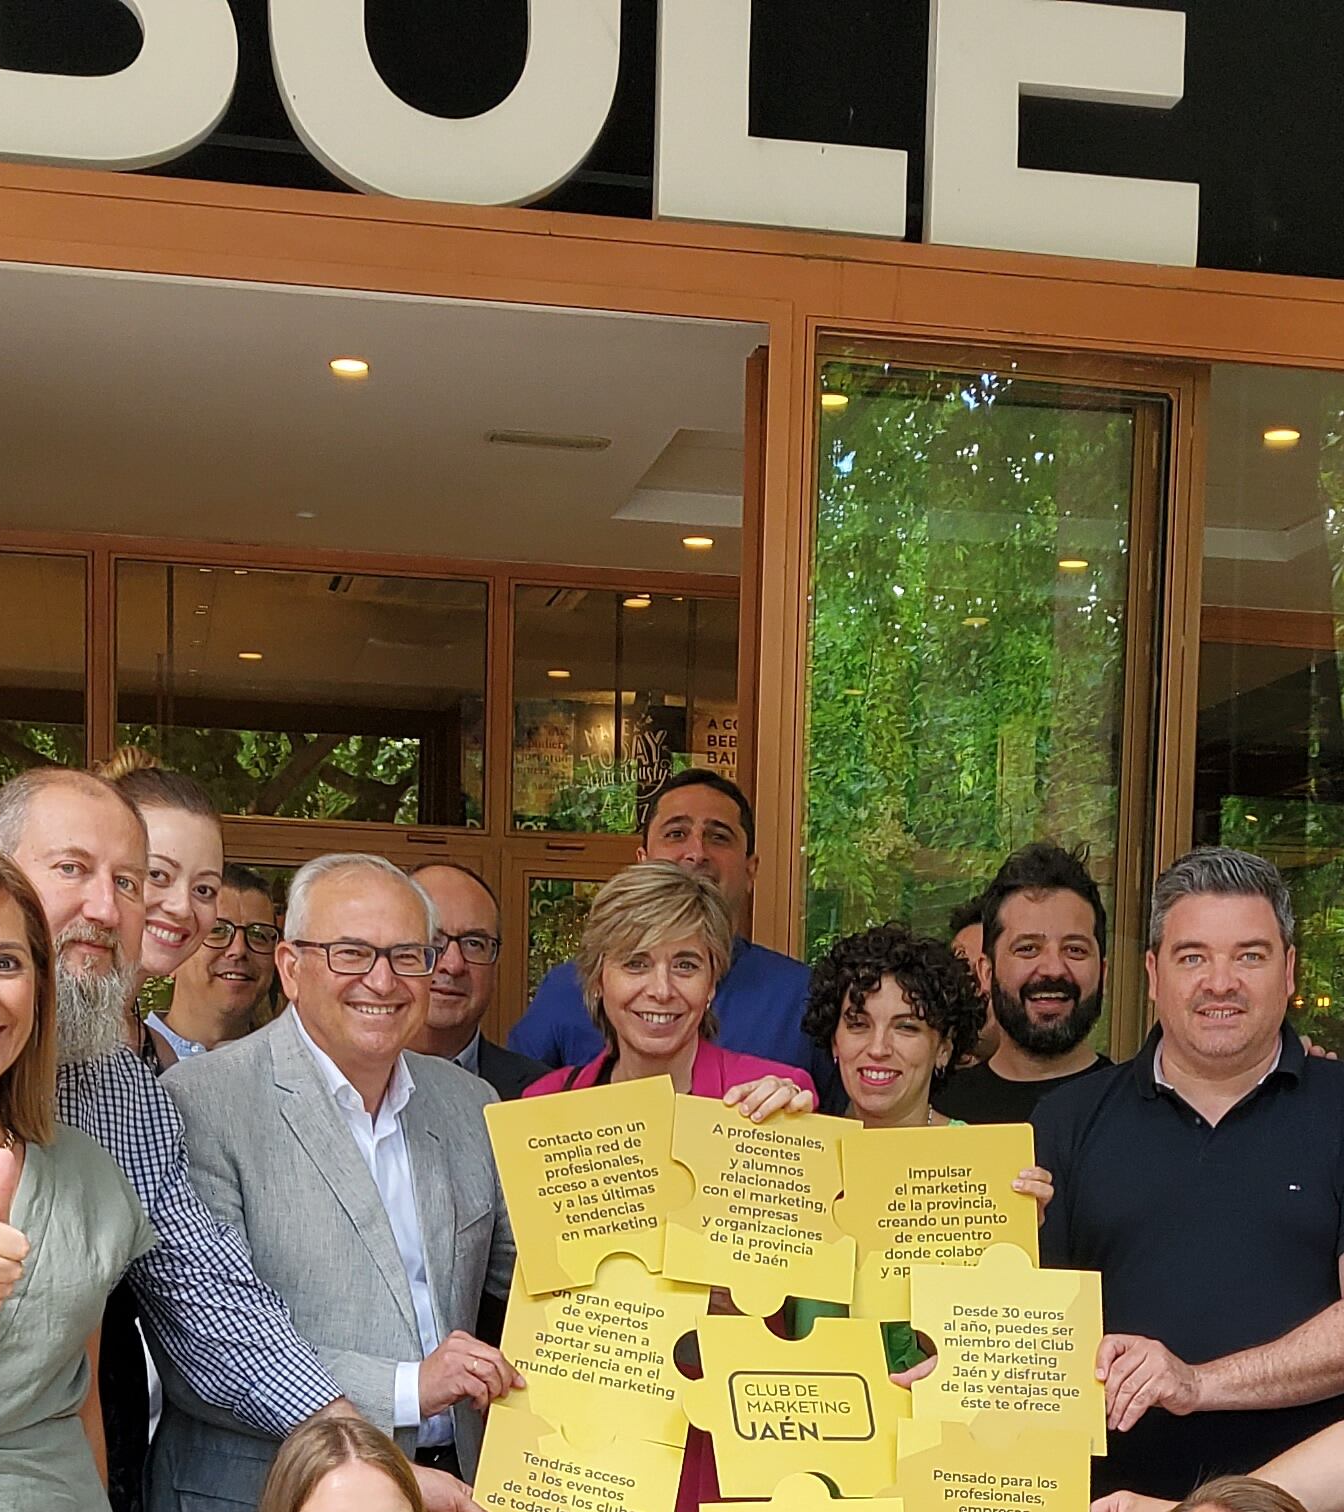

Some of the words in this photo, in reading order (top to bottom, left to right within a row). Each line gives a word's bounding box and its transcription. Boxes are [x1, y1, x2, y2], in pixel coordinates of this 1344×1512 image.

[528, 1130, 593, 1149] Contacto
[596, 1125, 623, 1138] con
[626, 1121, 646, 1133] un
[727, 1127, 825, 1152] profesionales,
[544, 1144, 593, 1163] amplia
[595, 1138, 620, 1155] red
[623, 1136, 642, 1149] de
[735, 1141, 801, 1162] docentes
[545, 1154, 644, 1183] profesionales,
[742, 1158, 804, 1177] alumnos
[908, 1165, 972, 1182] Impulsar
[537, 1180, 587, 1197] acceso
[602, 1167, 659, 1185] eventos
[720, 1171, 811, 1194] relacionados
[911, 1180, 987, 1196] marketing
[577, 1193, 599, 1207] las
[601, 1184, 656, 1202] últimas
[702, 1185, 729, 1198] con
[749, 1191, 826, 1214] marketing,
[887, 1199, 906, 1212] de
[926, 1195, 997, 1214] provincia,
[565, 1201, 645, 1225] tendencias
[728, 1204, 799, 1223] empresas
[877, 1214, 937, 1229] creando
[941, 1216, 960, 1227] un
[964, 1212, 1008, 1229] punto
[561, 1230, 580, 1242] en
[583, 1215, 658, 1238] marketing
[714, 1218, 823, 1241] organizaciones
[894, 1231, 913, 1244] de
[917, 1230, 992, 1243] encuentro
[710, 1230, 728, 1243] de
[748, 1238, 813, 1256] provincia
[884, 1246, 931, 1260] donde
[935, 1244, 986, 1258] colabo
[732, 1249, 751, 1262] de
[754, 1252, 788, 1268] Jaén
[575, 1292, 610, 1308] gran
[614, 1301, 665, 1319] equipo
[953, 1305, 999, 1318] Desde
[1001, 1307, 1020, 1319] 30
[1024, 1310, 1064, 1321] euros
[562, 1304, 581, 1317] de
[585, 1310, 649, 1331] expertos
[943, 1319, 956, 1332] al
[960, 1320, 991, 1335] año,
[995, 1322, 1048, 1336] puedes
[1051, 1327, 1074, 1337] ser
[555, 1320, 584, 1334] que
[588, 1324, 637, 1345] vienen
[944, 1334, 1011, 1349] miembro
[1014, 1337, 1037, 1350] del
[1040, 1338, 1074, 1352] Club
[535, 1332, 591, 1351] aportar
[593, 1343, 611, 1355] su
[614, 1347, 664, 1365] amplia
[960, 1350, 980, 1363] de
[983, 1351, 1057, 1369] Marketing
[535, 1348, 620, 1372] experiencia
[624, 1365, 643, 1377] en
[646, 1368, 660, 1380] el
[952, 1365, 988, 1378] Jaén
[1004, 1367, 1067, 1382] disfrutar
[514, 1359, 568, 1378] mundo
[571, 1369, 595, 1383] del
[598, 1375, 675, 1401] marketing
[745, 1384, 790, 1396] CLUB
[794, 1384, 819, 1397] DE
[940, 1380, 960, 1393] de
[963, 1381, 984, 1393] las
[986, 1383, 1048, 1398] ventajas
[1051, 1387, 1080, 1400] que
[747, 1400, 851, 1414] MARKETING
[960, 1396, 992, 1409] éste
[994, 1399, 1010, 1410] te
[1013, 1398, 1061, 1412] ofrece
[737, 1416, 820, 1440] JAÉN
[523, 1451, 582, 1475] Tendrás
[584, 1469, 636, 1488] acceso
[933, 1469, 997, 1485] Pensado
[1000, 1476, 1033, 1489] para
[1037, 1475, 1058, 1490] los
[503, 1480, 522, 1494] de
[526, 1485, 568, 1504] todos
[571, 1494, 593, 1510] los
[541, 1471, 563, 1487] los
[566, 1480, 625, 1501] eventos
[944, 1487, 1045, 1507] profesionales,
[486, 1492, 506, 1506] de
